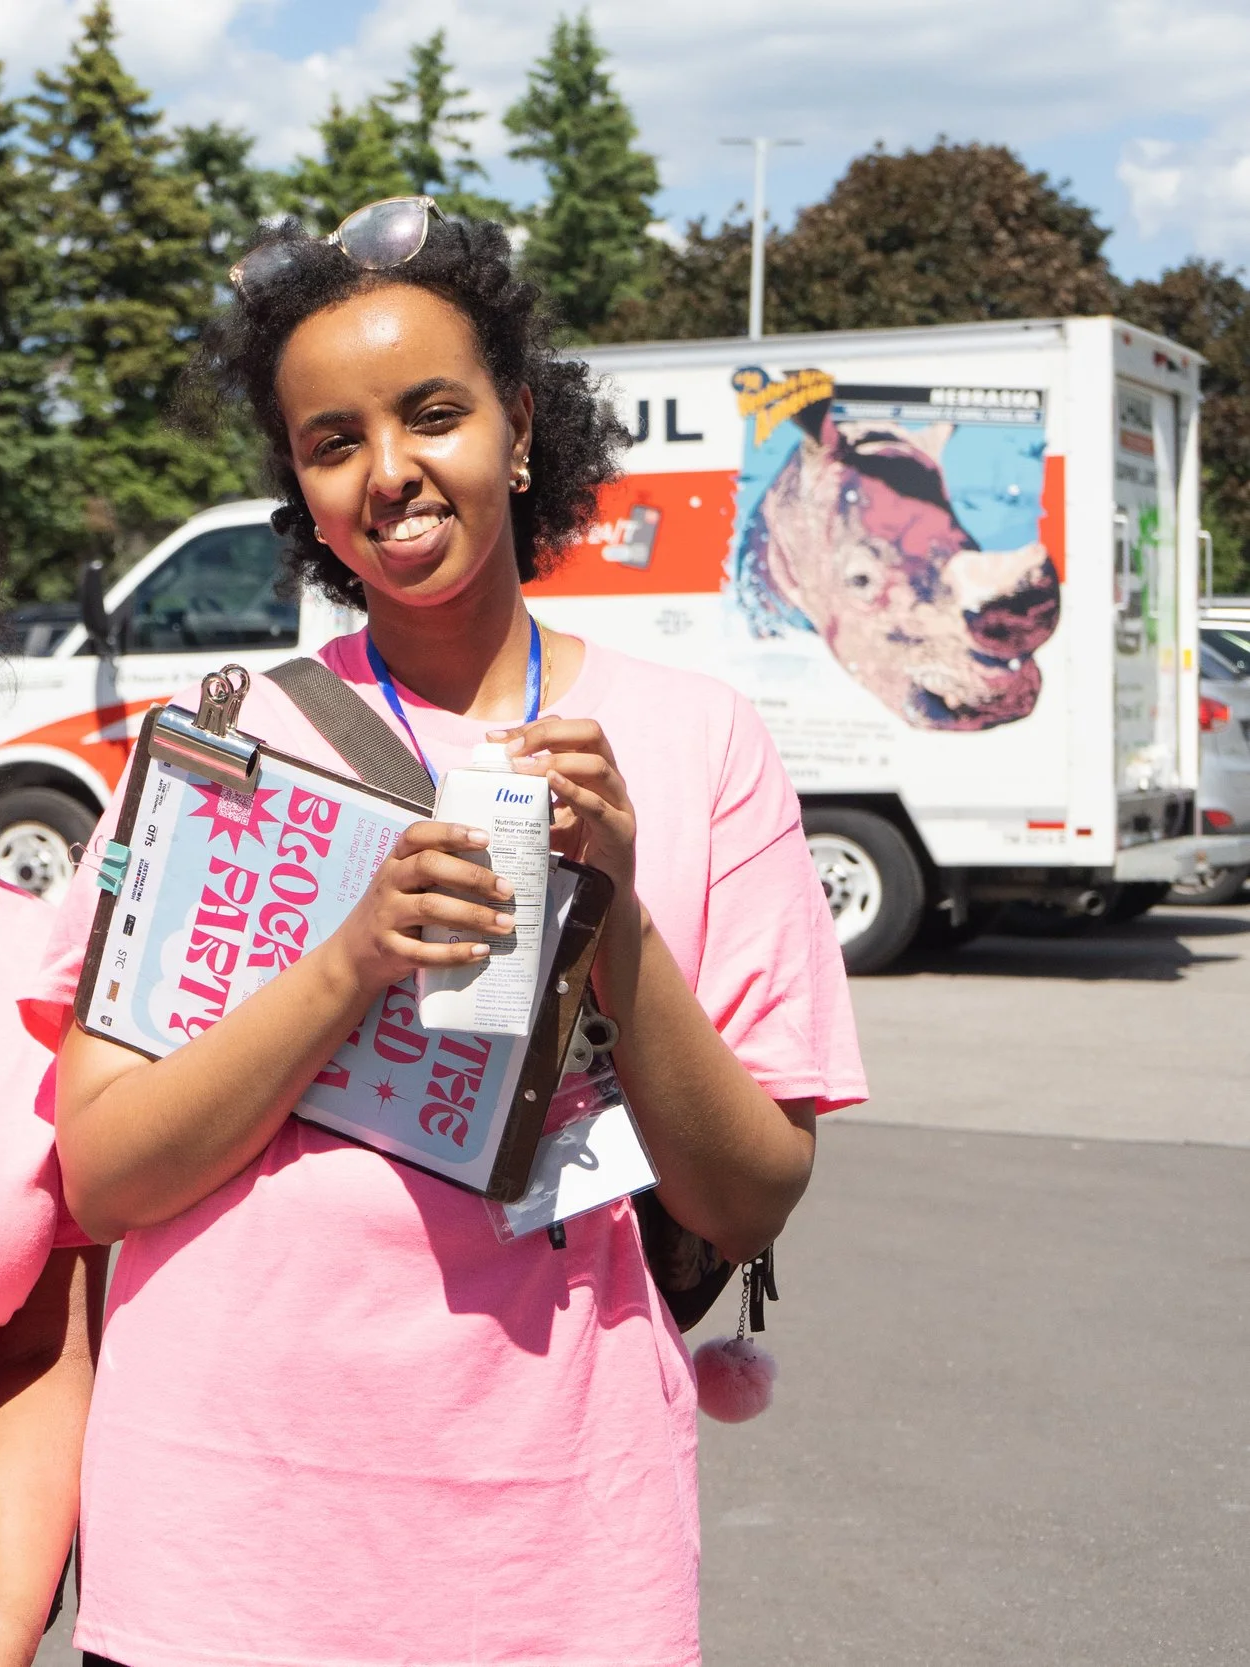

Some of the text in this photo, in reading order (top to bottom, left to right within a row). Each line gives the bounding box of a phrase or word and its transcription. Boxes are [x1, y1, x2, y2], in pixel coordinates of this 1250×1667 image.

[495, 787, 534, 804] flow
[494, 819, 524, 827] Nutrition
[144, 824, 156, 846] arts
[372, 827, 390, 869] CENTRE
[248, 785, 341, 970] BLOCK
[339, 866, 351, 890] JUNE
[354, 855, 366, 879] JUNE
[336, 892, 345, 902] 13
[351, 881, 360, 891] 12
[114, 949, 127, 969] STC
[169, 855, 259, 1041] PARTY
[418, 1036, 491, 1147] THE
